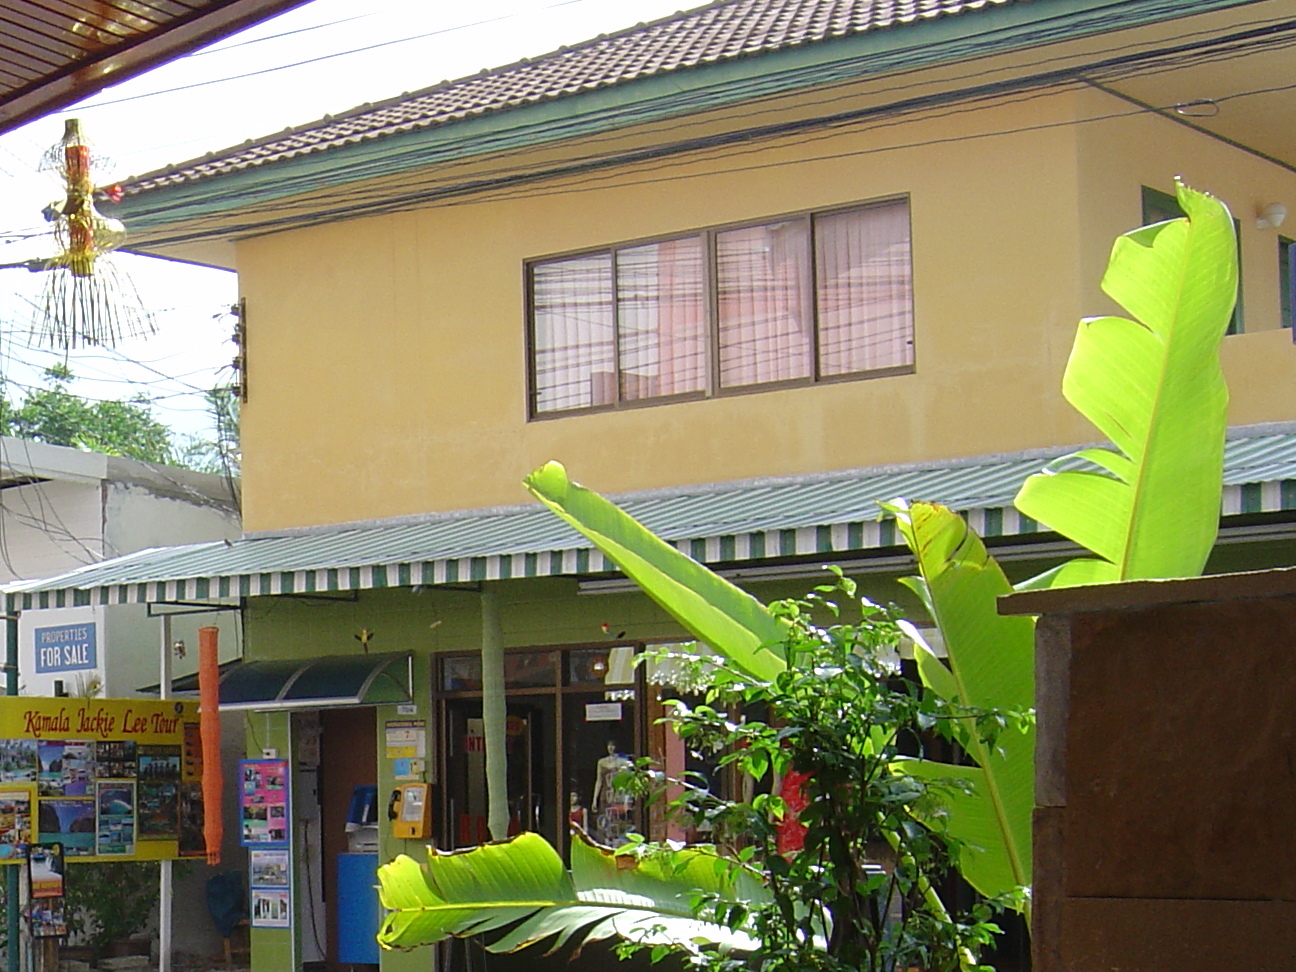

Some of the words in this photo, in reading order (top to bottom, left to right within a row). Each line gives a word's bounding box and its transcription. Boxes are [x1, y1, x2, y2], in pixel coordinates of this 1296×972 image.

[41, 628, 88, 643] PROPERTIES
[40, 647, 61, 668] FOR
[64, 643, 89, 665] SALE
[23, 710, 70, 738] Kamala
[76, 707, 115, 738] Jackie
[122, 709, 147, 734] Lee
[151, 712, 179, 734] Tour
